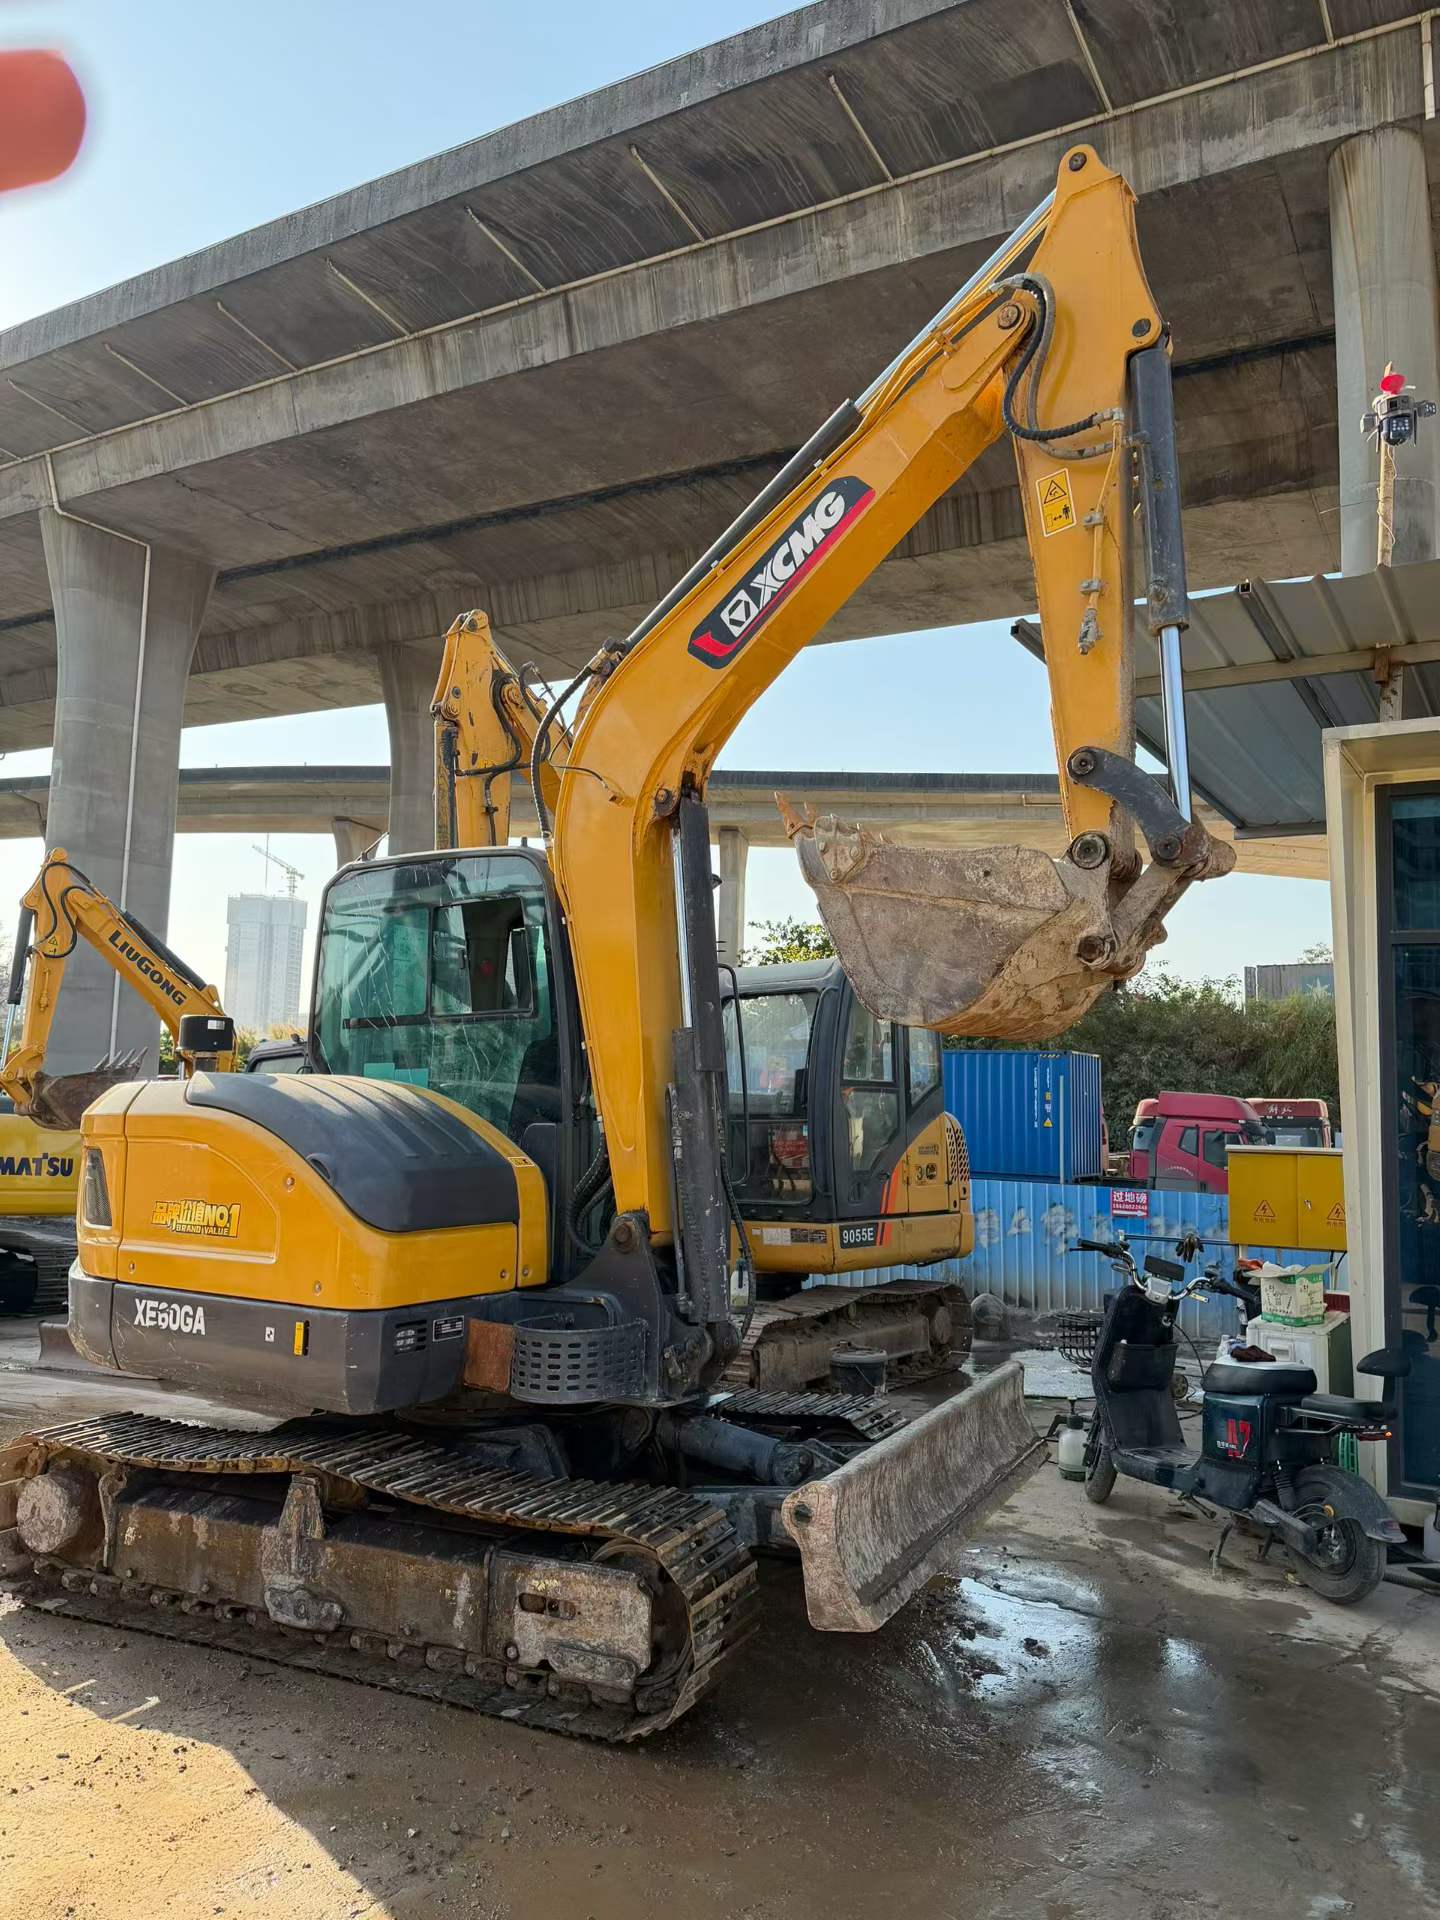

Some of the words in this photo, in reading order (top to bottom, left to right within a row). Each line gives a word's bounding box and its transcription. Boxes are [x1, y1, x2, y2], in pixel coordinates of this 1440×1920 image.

[750, 491, 845, 610] XCMG
[108, 929, 187, 1006] LIUGONG
[1113, 1191, 1147, 1204] 过地磅
[176, 1224, 201, 1234] BRAND
[204, 1226, 229, 1236] VALUE
[842, 1227, 875, 1244] 9055E
[133, 1298, 206, 1336] XE60GA
